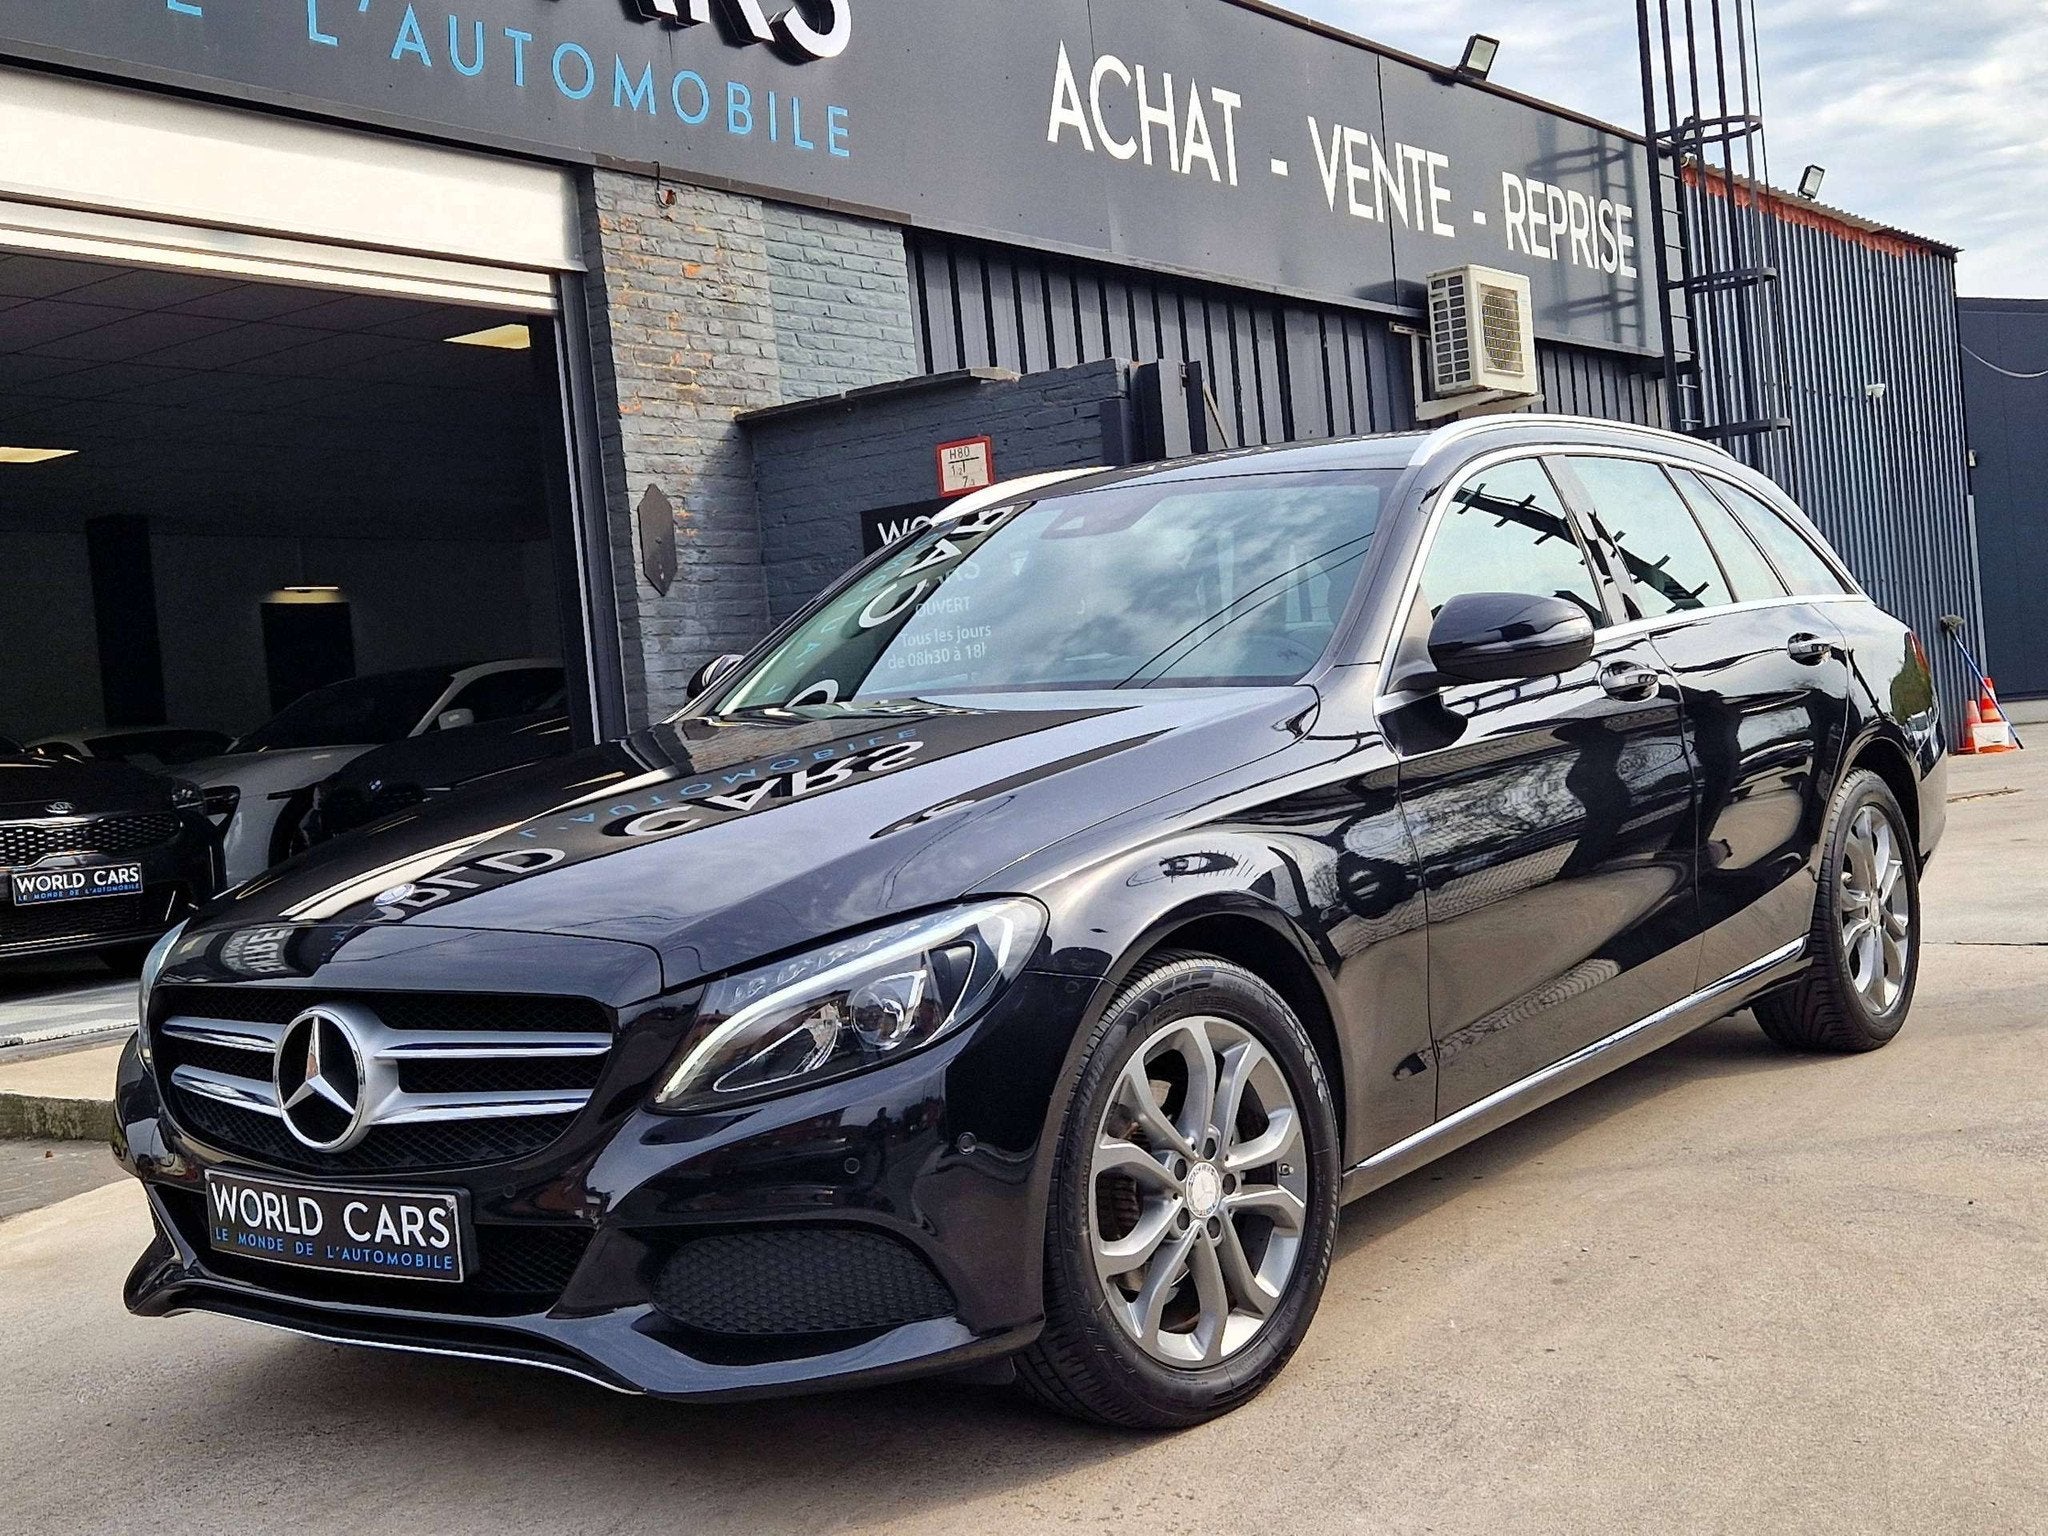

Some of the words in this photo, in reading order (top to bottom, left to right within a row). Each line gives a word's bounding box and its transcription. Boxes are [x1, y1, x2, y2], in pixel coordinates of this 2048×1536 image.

[1047, 39, 1241, 187] ACHAT
[1308, 116, 1455, 238] VENTE
[1502, 171, 1638, 279] REPRISE
[949, 446, 970, 460] H80
[915, 596, 971, 617] OUVERT
[900, 631, 931, 648] Tous
[935, 628, 953, 642] les
[957, 624, 992, 644] jours
[888, 655, 906, 669] de
[908, 648, 950, 667] 08h30
[953, 647, 961, 661] à
[16, 872, 86, 894] WORLD
[94, 866, 140, 886] CARS
[210, 1182, 323, 1236] WORLD
[343, 1201, 451, 1249] CARS
[215, 1226, 229, 1242] LE
[238, 1232, 284, 1252] MONDE
[295, 1242, 313, 1256] DE
[327, 1245, 453, 1270] L'AUTOMOBILE
